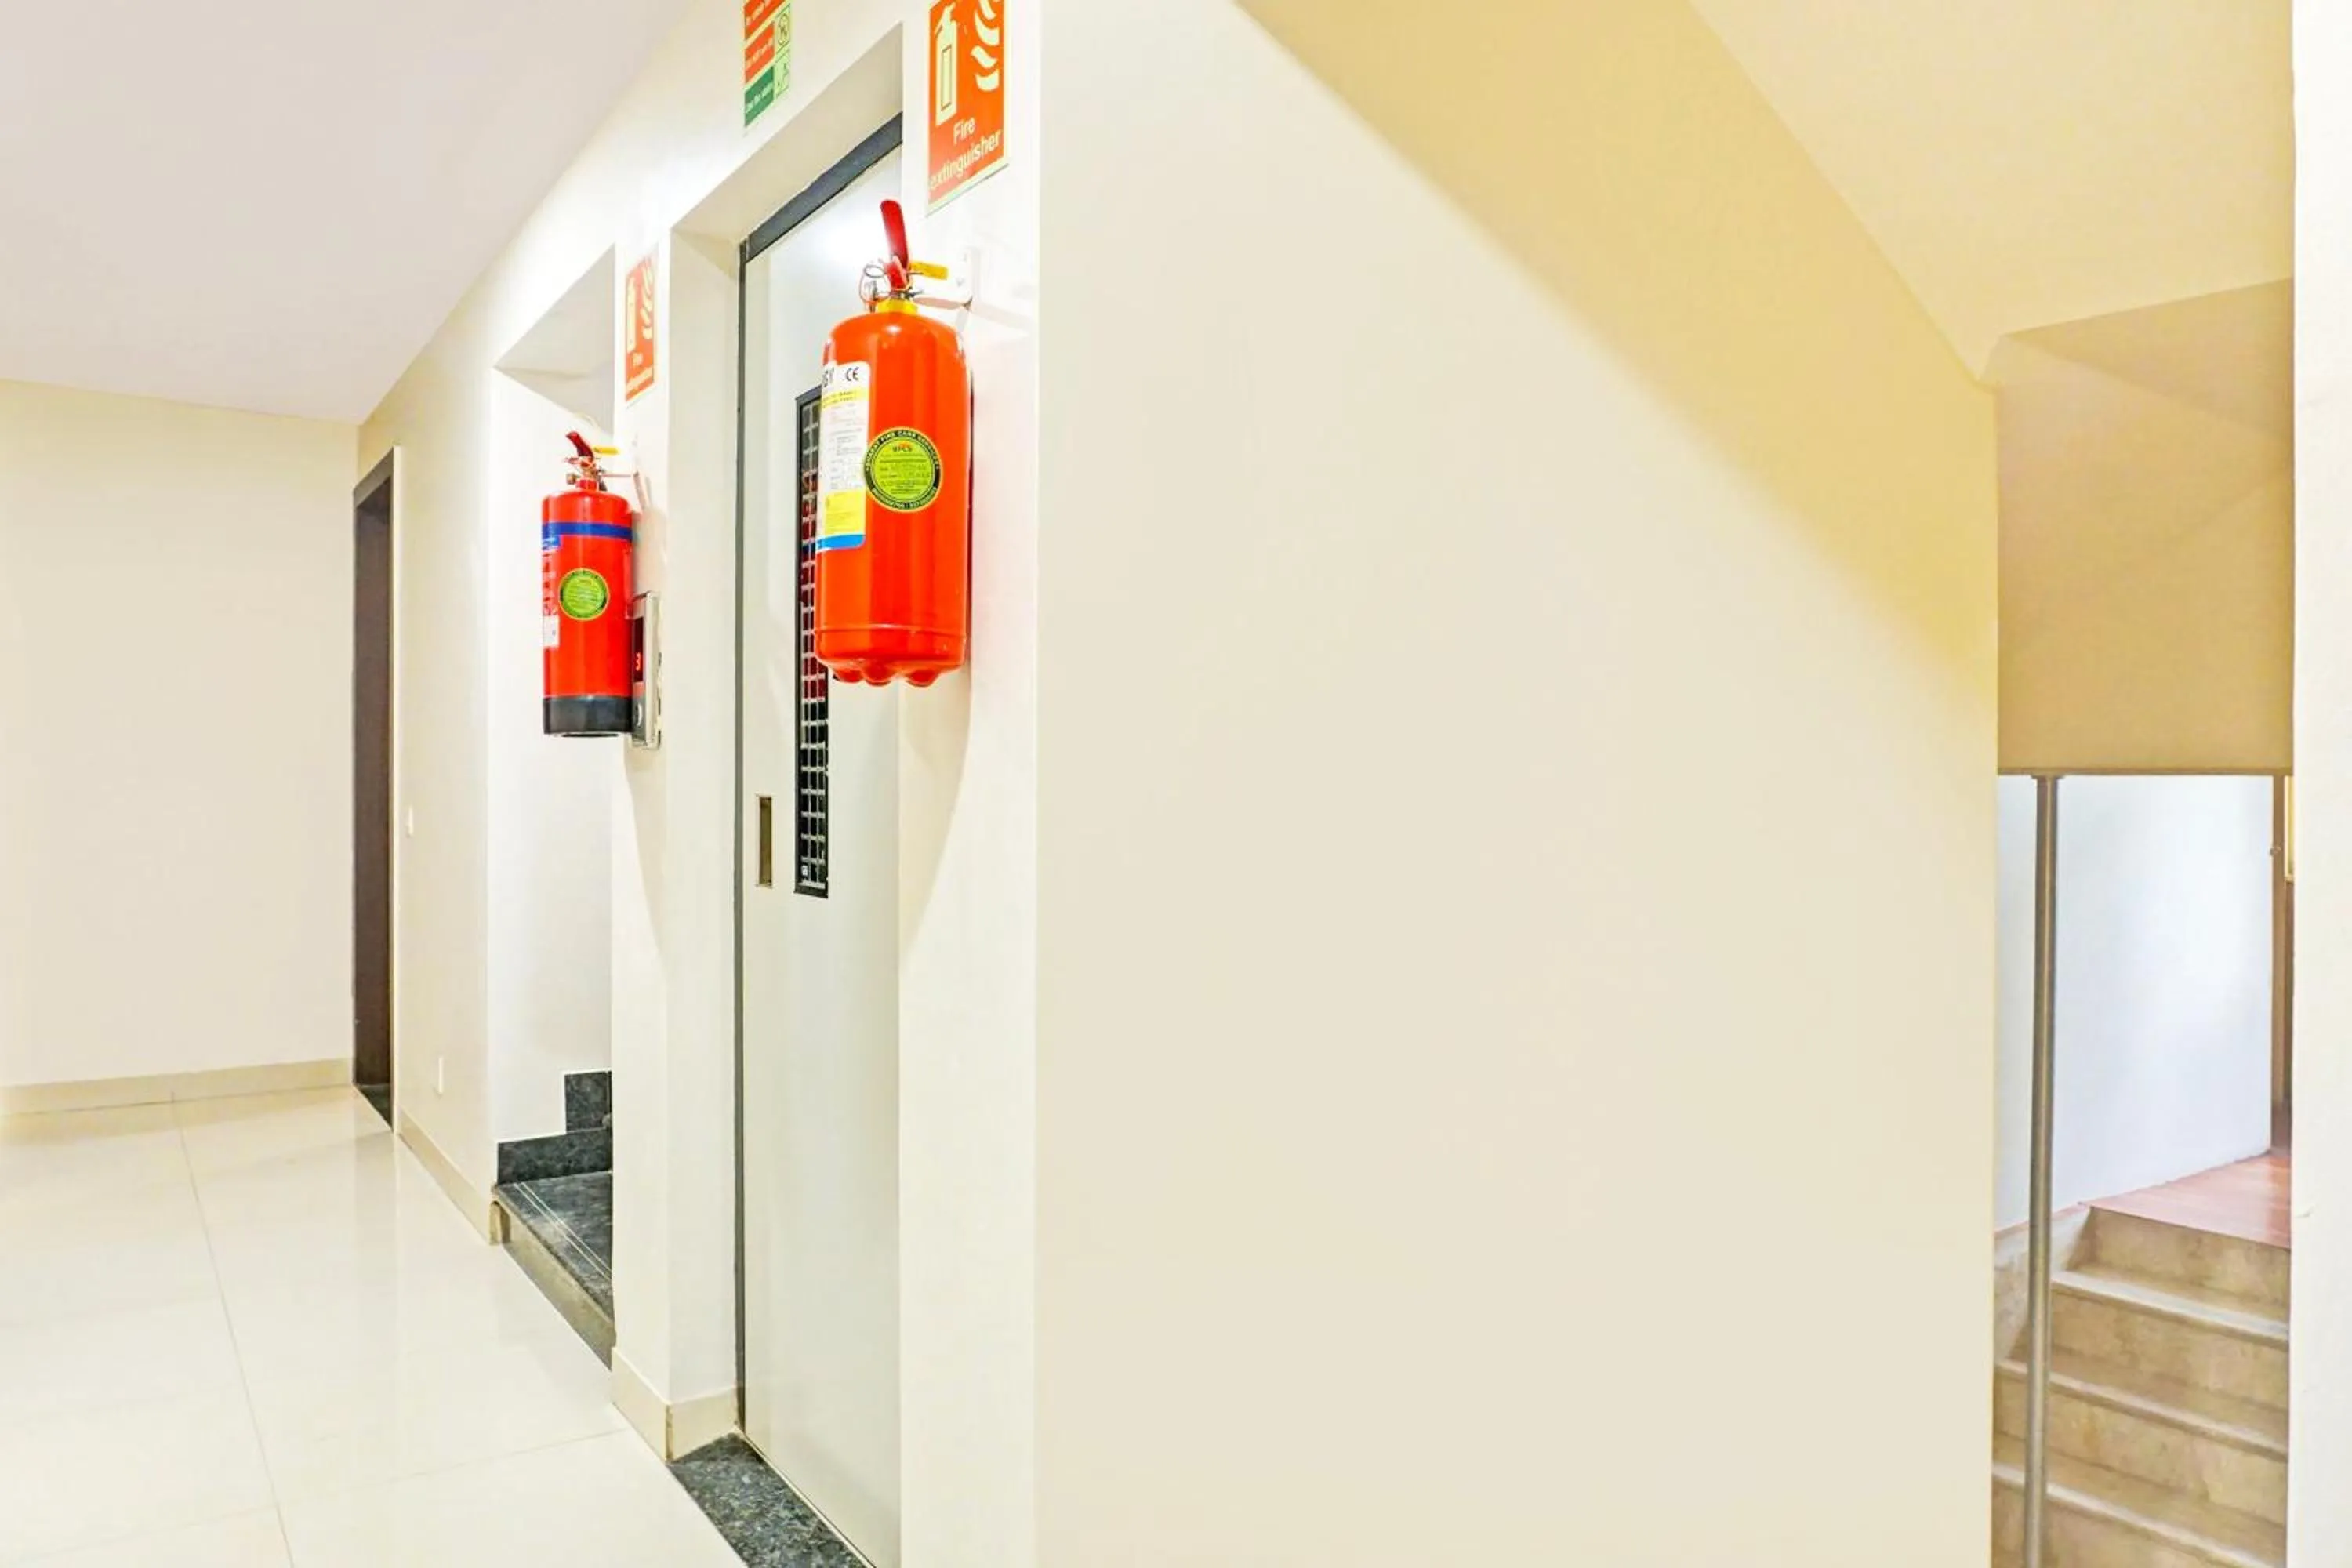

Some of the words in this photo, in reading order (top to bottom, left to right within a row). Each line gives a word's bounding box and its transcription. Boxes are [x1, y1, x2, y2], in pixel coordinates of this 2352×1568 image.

[953, 117, 976, 145] Fire
[931, 129, 1001, 191] extinguisher
[846, 366, 859, 382] CE
